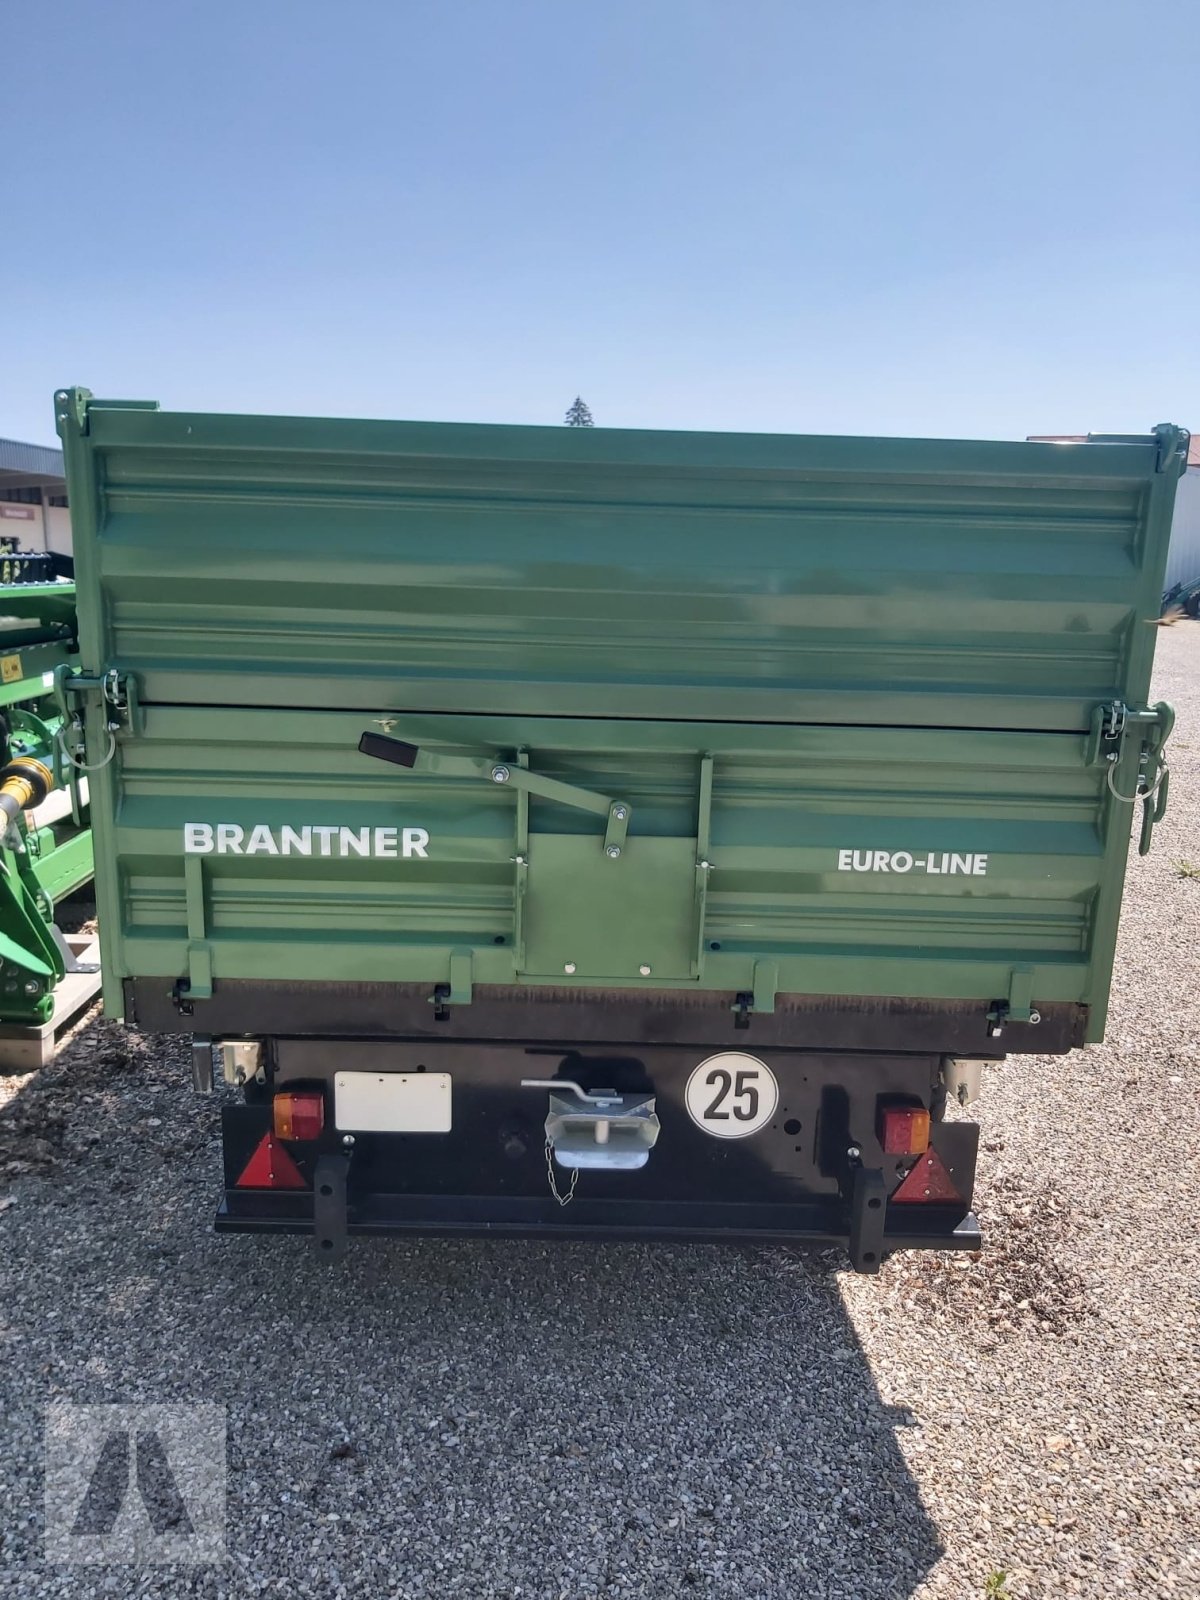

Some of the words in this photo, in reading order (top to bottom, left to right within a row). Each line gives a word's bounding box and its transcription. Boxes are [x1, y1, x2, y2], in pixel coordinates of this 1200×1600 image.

[184, 822, 430, 857] BRANTNER
[838, 849, 988, 876] EURO-LINE
[703, 1069, 759, 1121] 25
